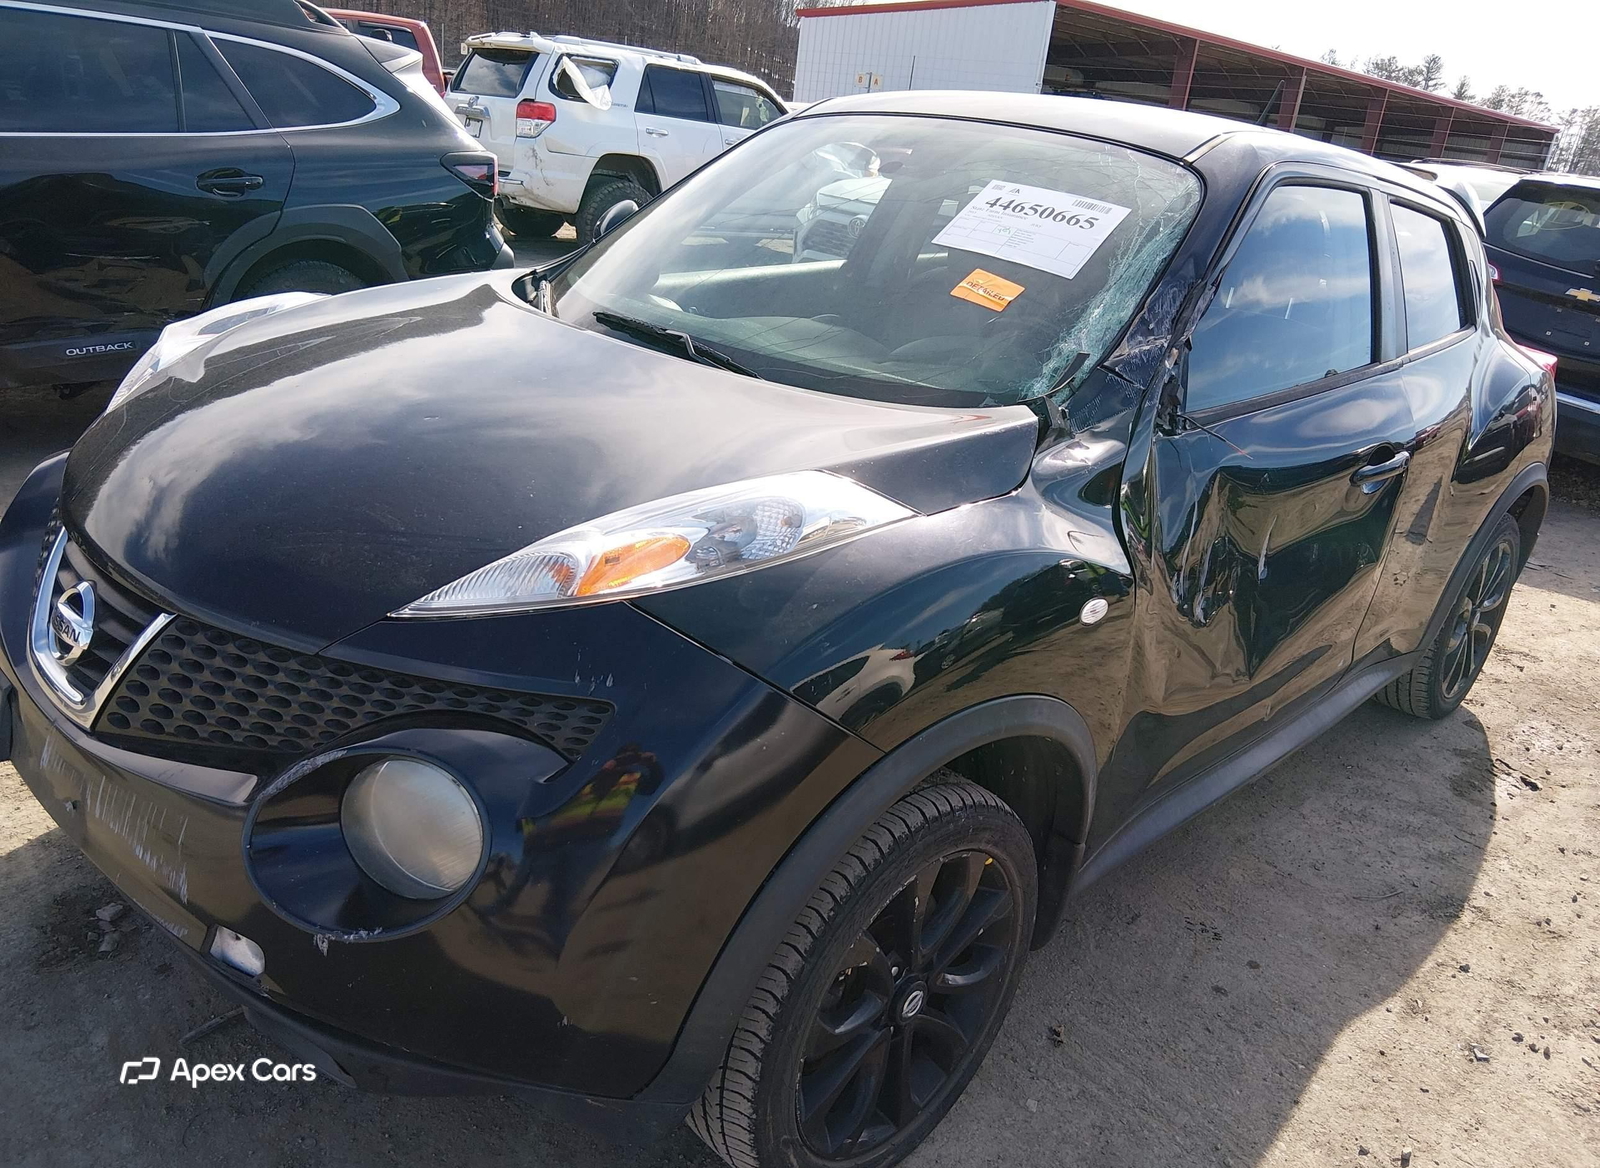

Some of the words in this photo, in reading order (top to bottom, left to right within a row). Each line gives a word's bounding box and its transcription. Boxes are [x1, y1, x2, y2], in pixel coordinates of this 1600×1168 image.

[984, 196, 1101, 231] 44650665
[65, 341, 133, 356] OUTBACK
[53, 613, 81, 643] SSAN
